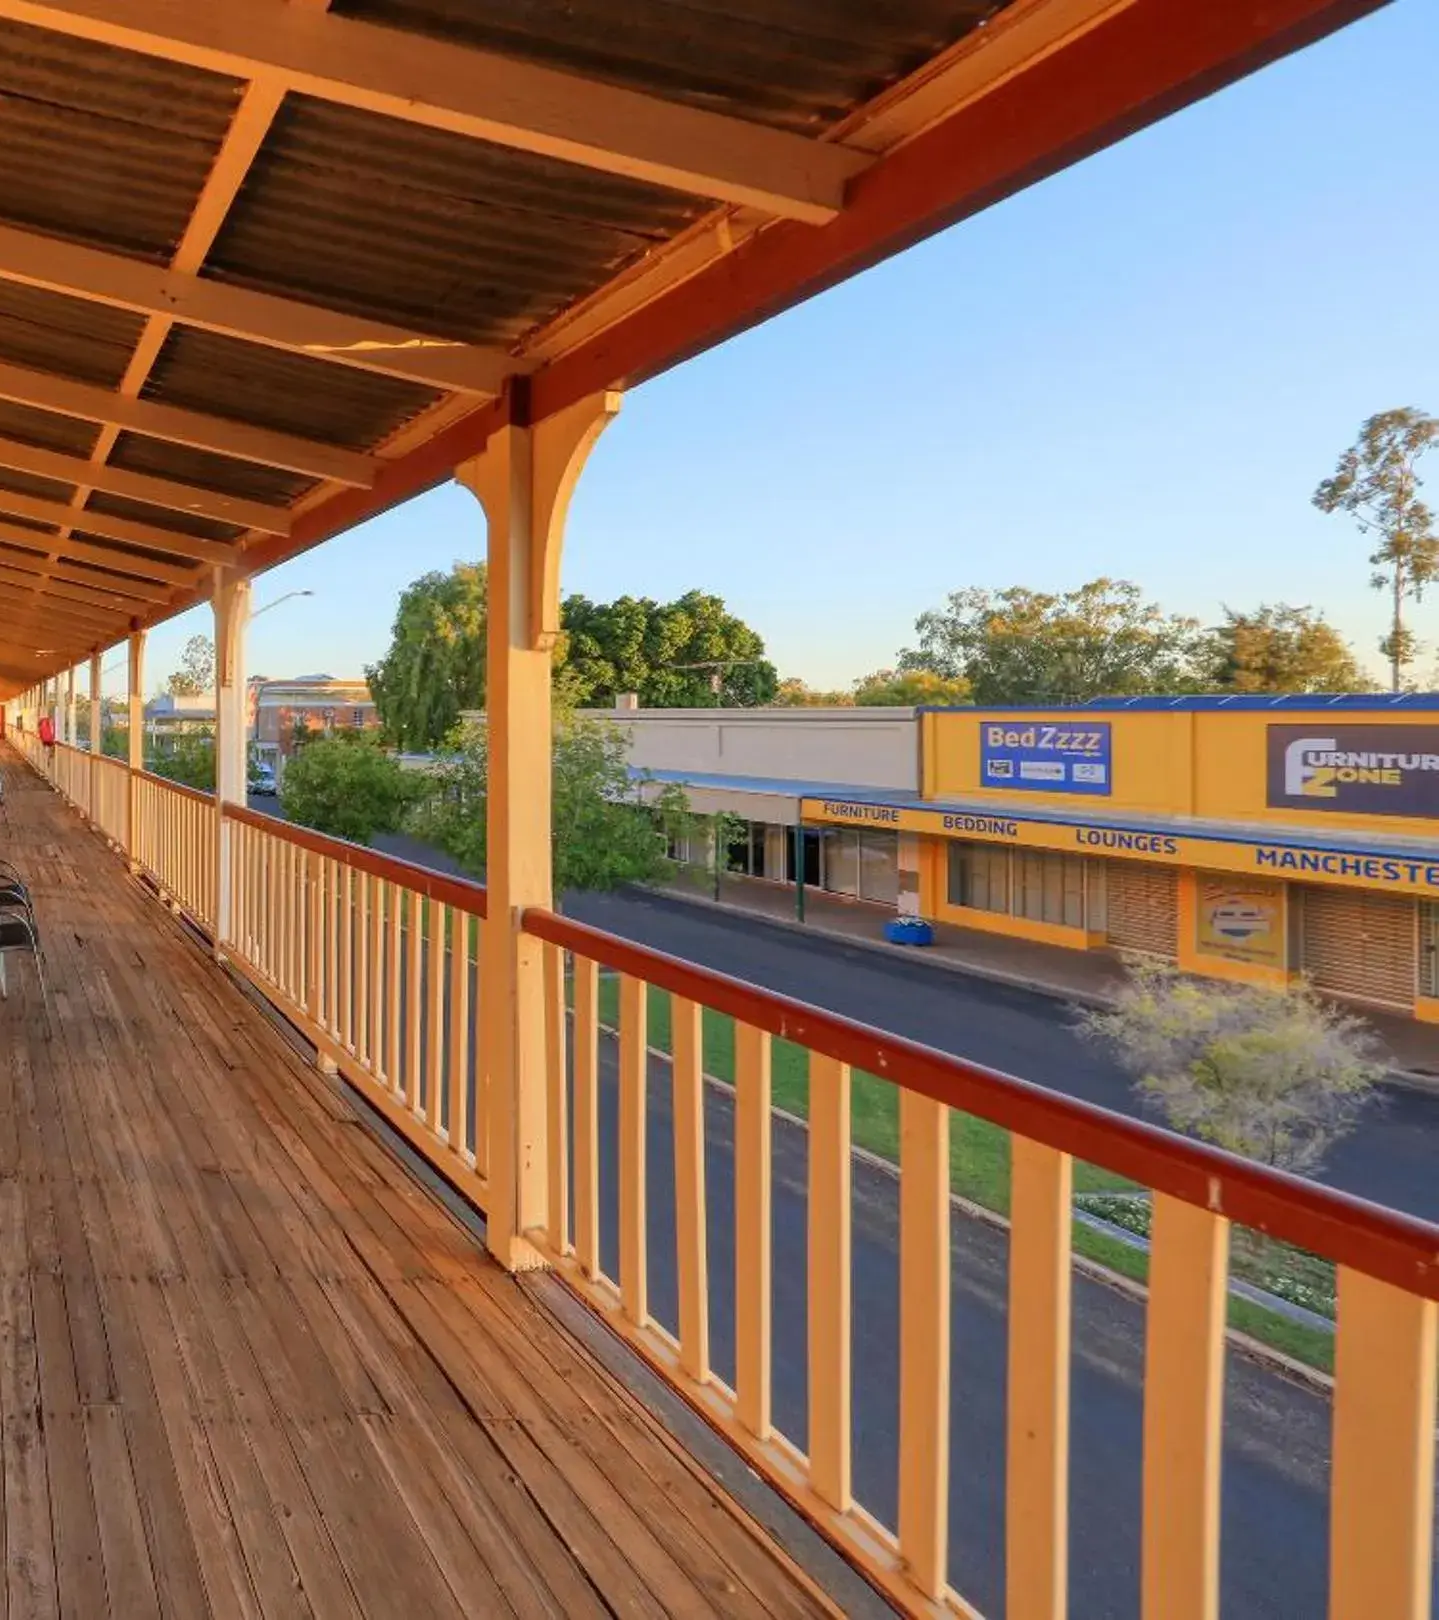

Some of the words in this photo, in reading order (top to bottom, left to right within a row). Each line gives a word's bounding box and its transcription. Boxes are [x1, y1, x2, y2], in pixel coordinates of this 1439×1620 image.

[1302, 767, 1402, 798] ZONE
[823, 801, 899, 823] FURNITURE
[943, 815, 1018, 837] BEDDING
[1075, 828, 1178, 855] LOUNGES
